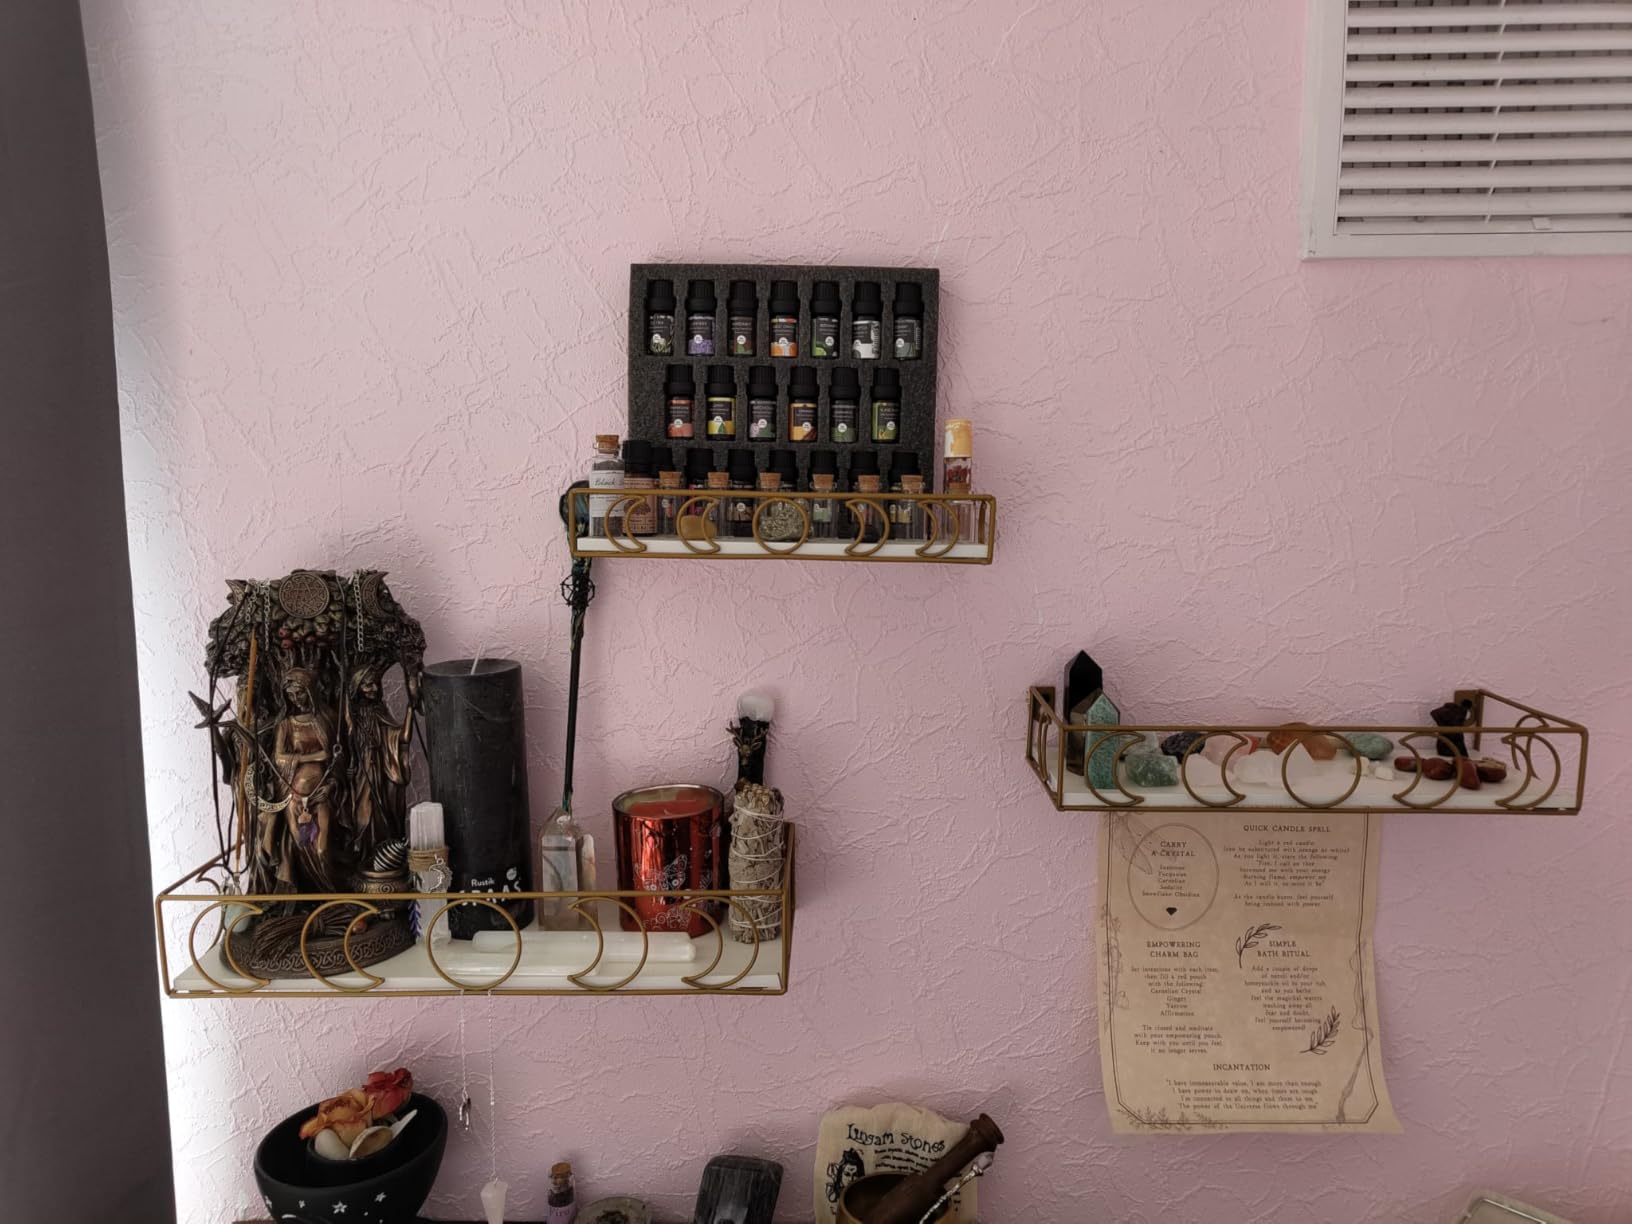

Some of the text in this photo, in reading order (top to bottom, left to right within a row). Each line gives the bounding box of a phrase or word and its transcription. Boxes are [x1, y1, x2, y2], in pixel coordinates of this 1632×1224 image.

[1243, 824, 1331, 832] QUICK CANDLE SPELL
[1160, 840, 1187, 848] CARRY
[471, 878, 495, 887] Rustik
[847, 1123, 946, 1153] Lingam Stones
